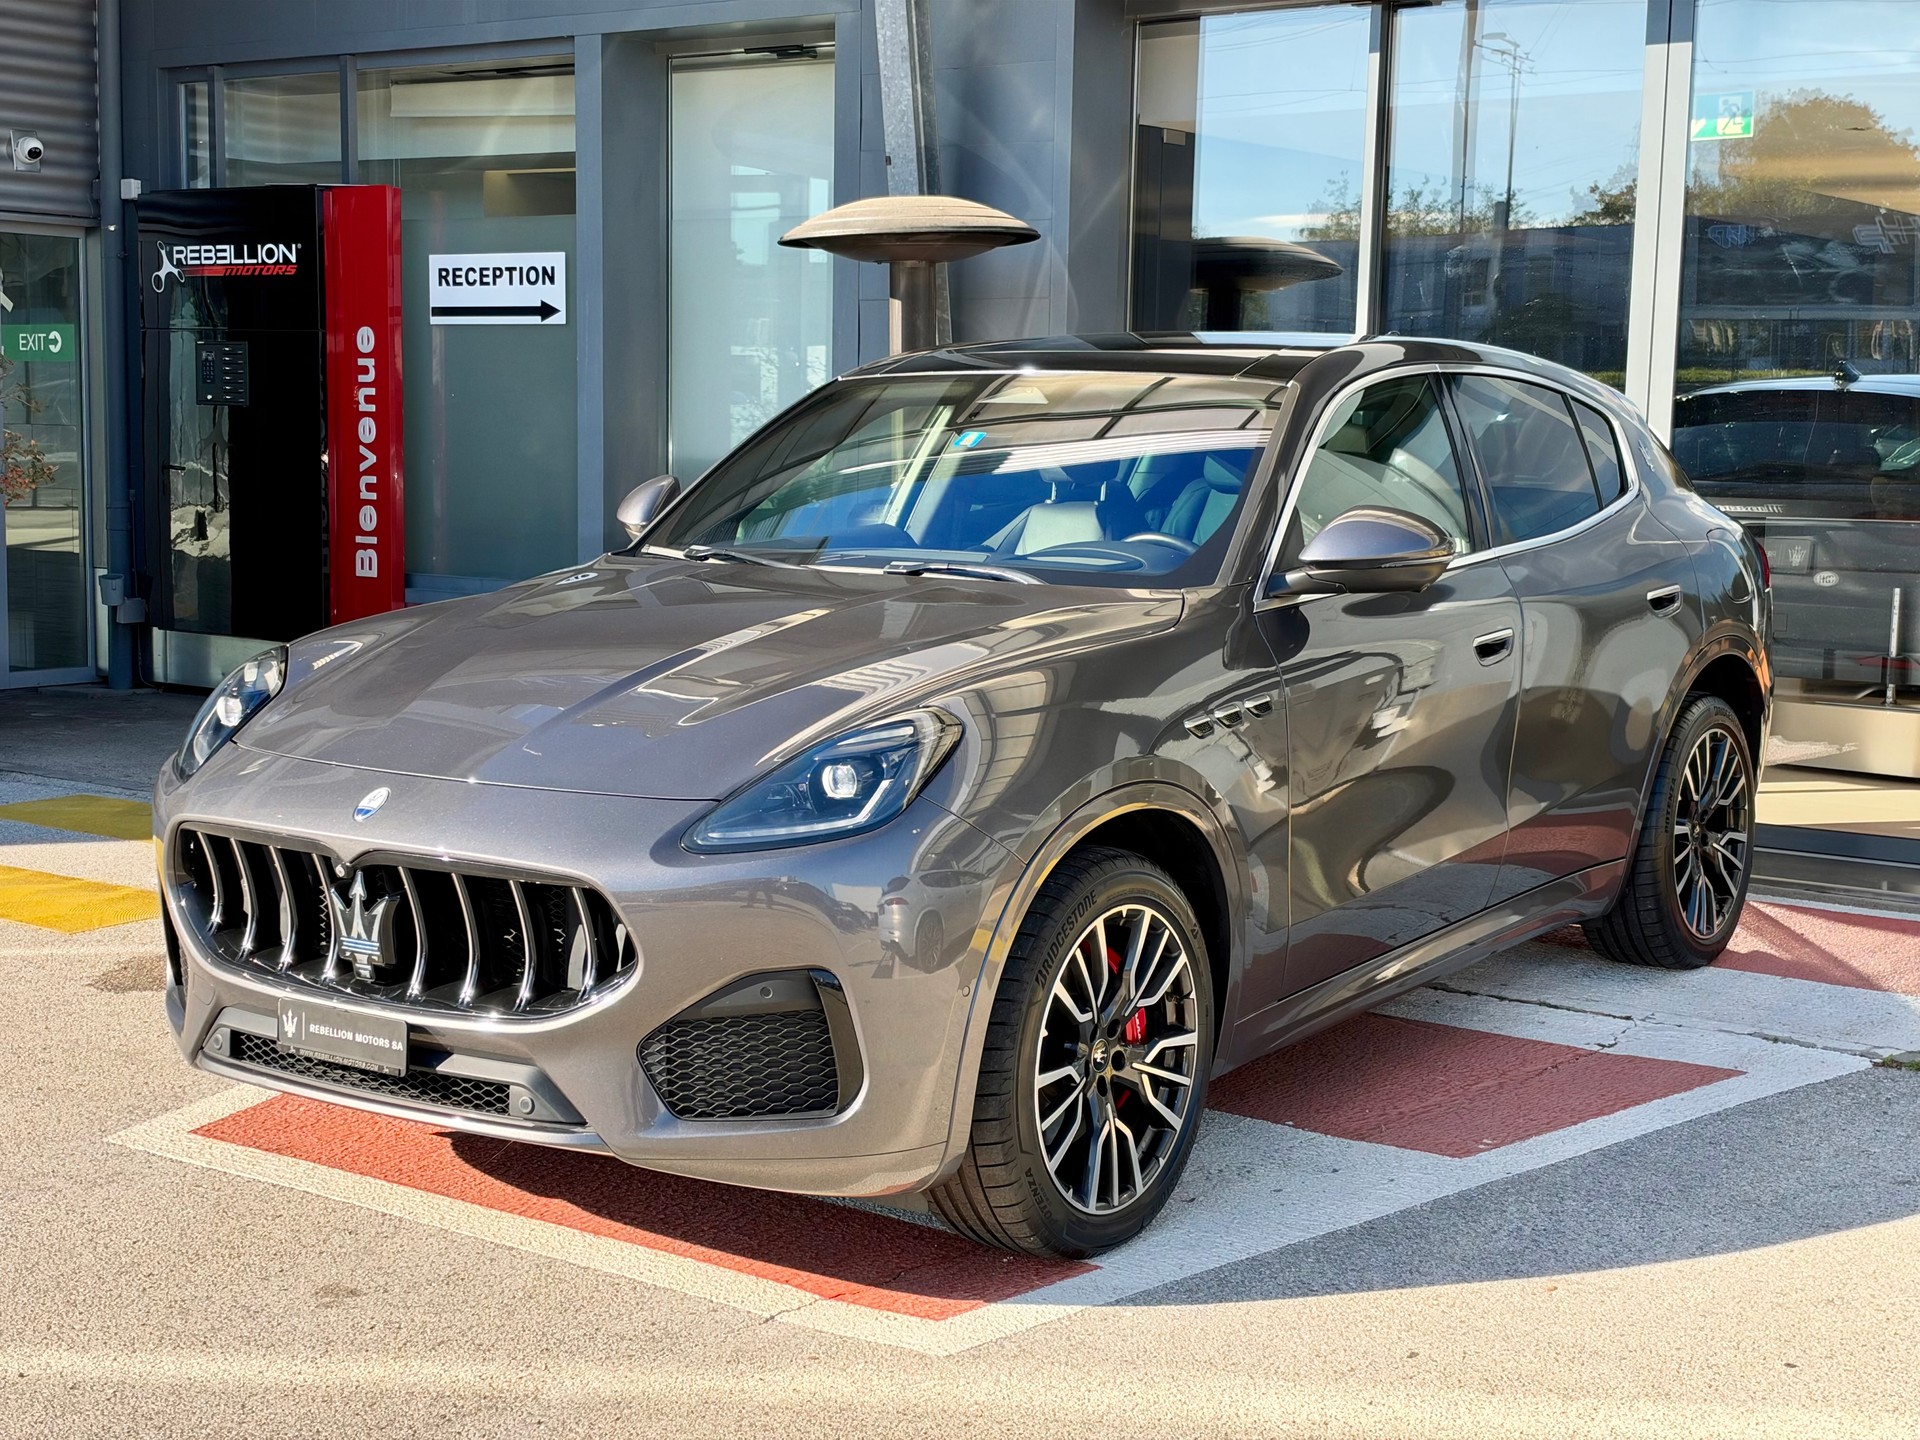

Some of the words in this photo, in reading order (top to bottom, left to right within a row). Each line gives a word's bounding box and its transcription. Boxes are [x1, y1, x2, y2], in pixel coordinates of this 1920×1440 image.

[438, 265, 555, 287] RECEPTION
[19, 333, 46, 351] EXIT
[1035, 889, 1098, 992] BRIDGESTONE
[309, 1023, 354, 1041] REBELLION
[354, 1032, 391, 1049] MOTORS
[391, 1041, 404, 1052] SA
